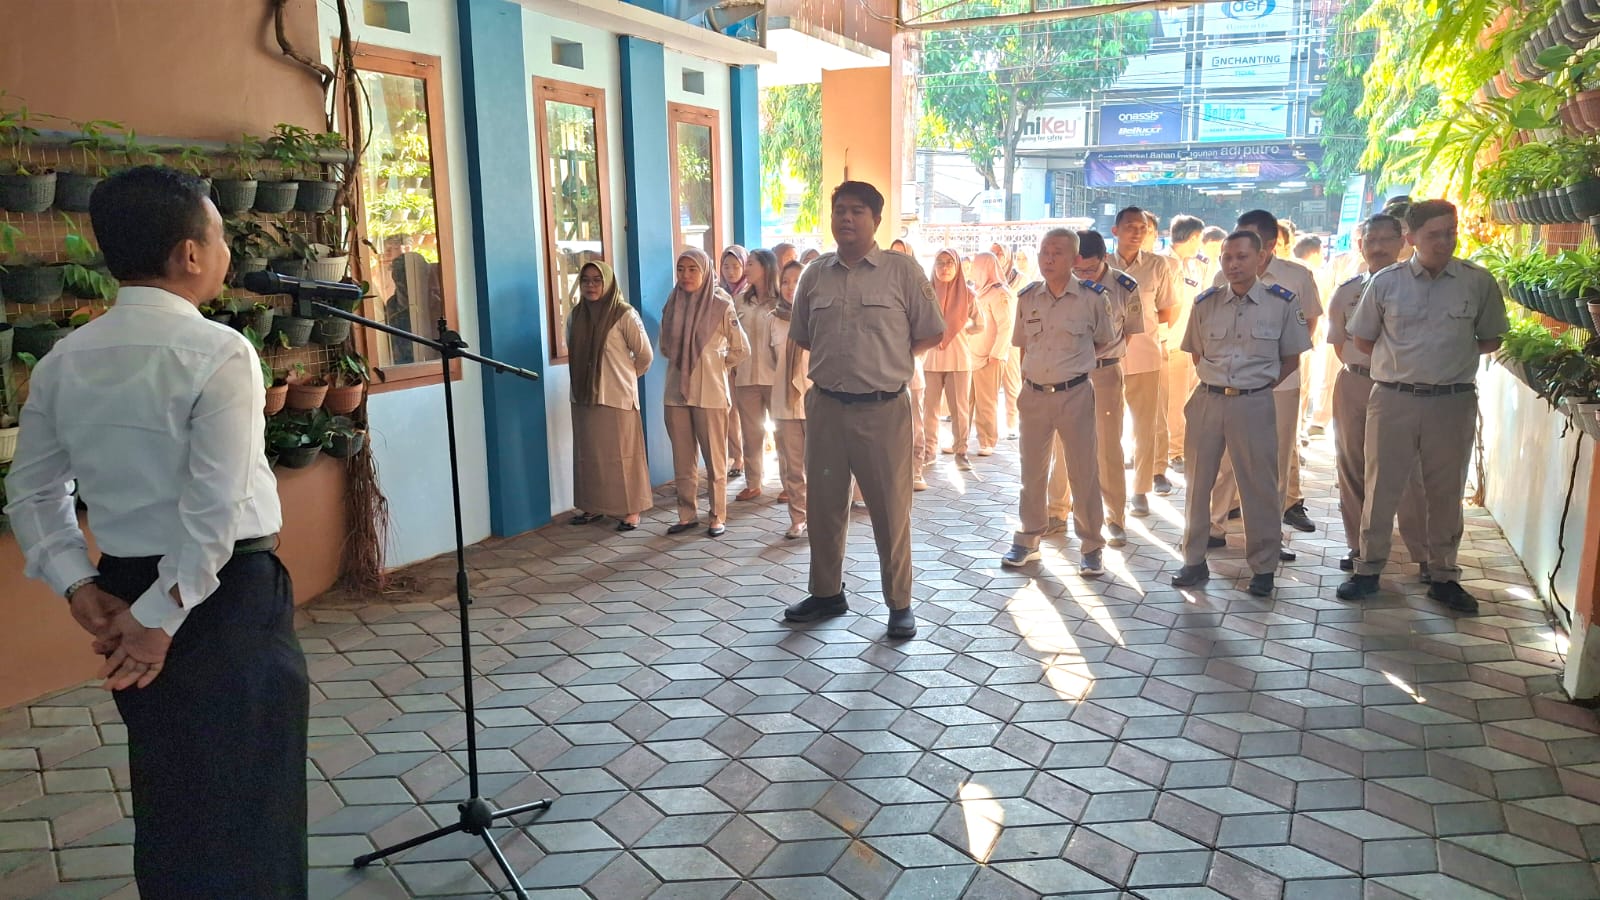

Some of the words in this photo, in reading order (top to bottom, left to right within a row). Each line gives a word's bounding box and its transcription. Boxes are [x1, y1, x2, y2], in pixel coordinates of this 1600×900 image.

[1118, 111, 1160, 121] onassis
[1019, 116, 1077, 139] niKey
[1150, 151, 1176, 159] Bahan
[1177, 150, 1218, 159] gunan
